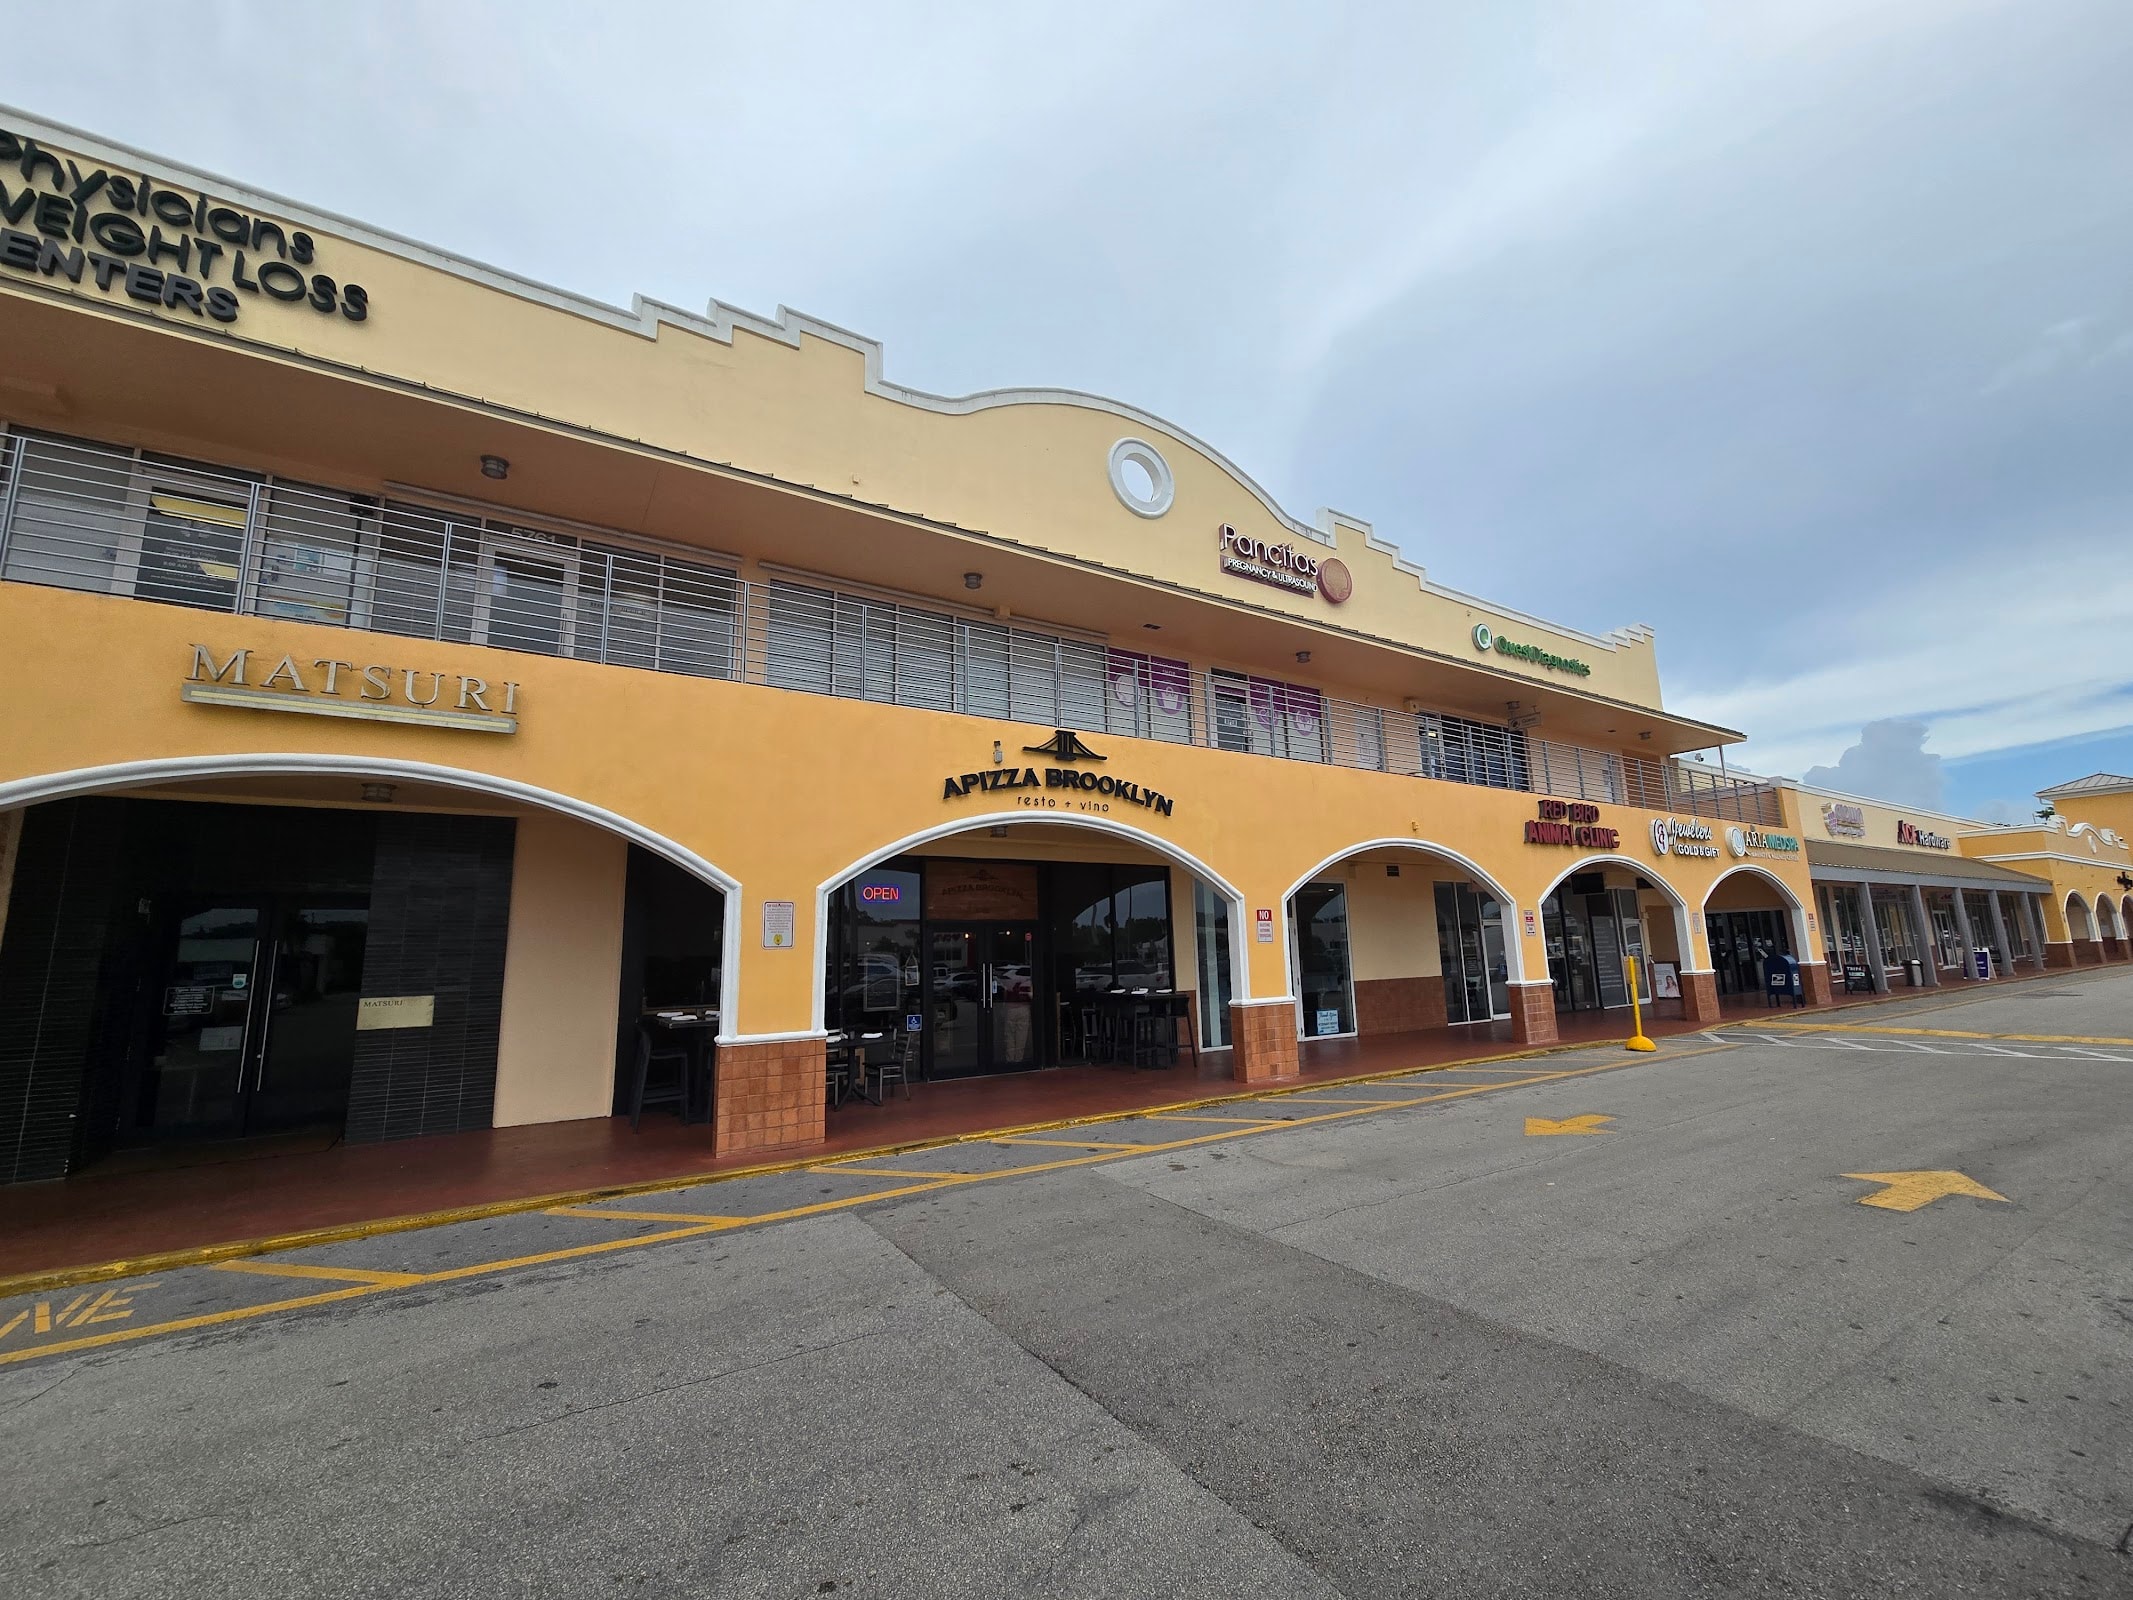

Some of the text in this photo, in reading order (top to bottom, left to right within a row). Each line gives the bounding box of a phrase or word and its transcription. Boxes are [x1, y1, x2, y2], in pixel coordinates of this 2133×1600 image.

[233, 249, 368, 321] LOSS
[1219, 523, 1319, 576] Pancitas
[1224, 557, 1318, 592] PREGNANCY & ULTRASOUND
[1494, 635, 1591, 678] Quest Diagnostics
[184, 643, 521, 715] MATSURI
[943, 767, 1174, 817] APIZZA BROOKLYN
[1017, 795, 1056, 809] resto
[1080, 802, 1109, 813] vino
[1538, 800, 1600, 823] RED BIRD
[1524, 820, 1621, 849] ANIMAL CLINIC
[1667, 816, 1714, 845] Jewelers
[1743, 830, 1800, 852] ARIA MEDSPA
[1897, 819, 1952, 850] ACE Hardware
[1674, 843, 1699, 856] GOLD
[1704, 846, 1721, 858] GIFT
[863, 886, 899, 900] OPEN
[1259, 910, 1270, 920] NO
[363, 1000, 403, 1008] MATSURI
